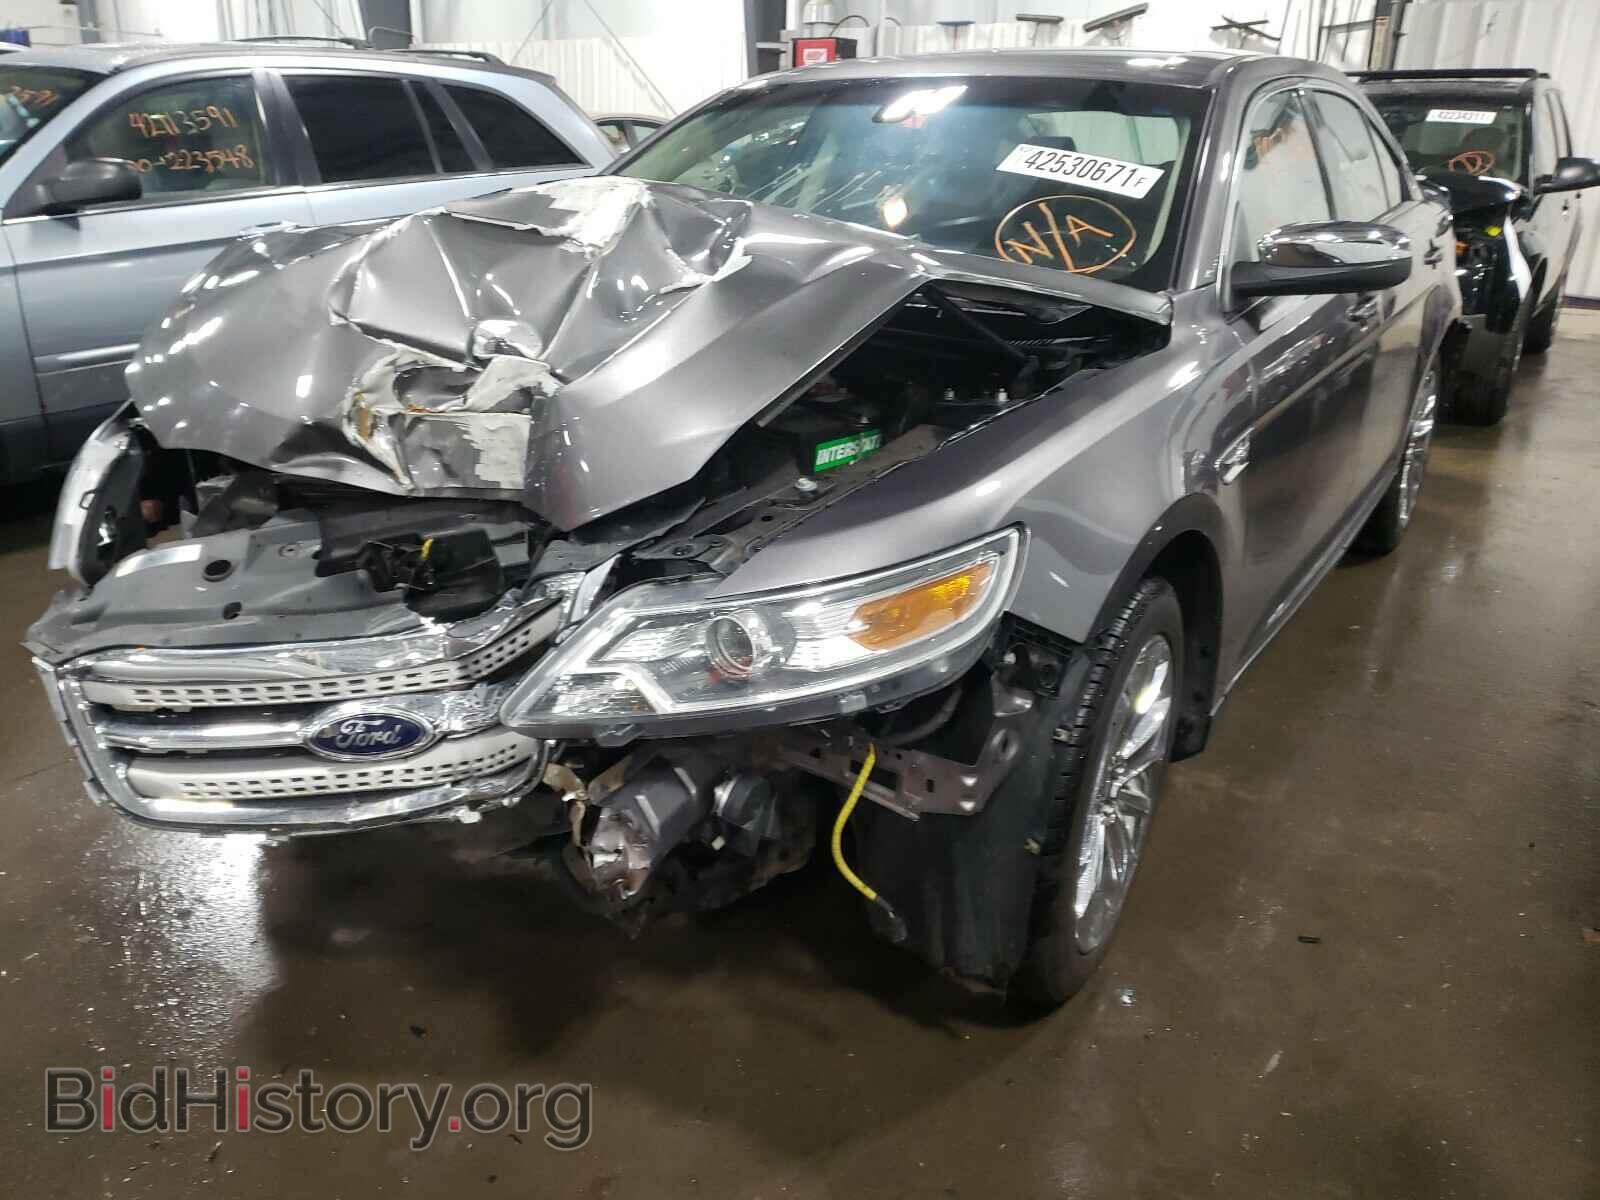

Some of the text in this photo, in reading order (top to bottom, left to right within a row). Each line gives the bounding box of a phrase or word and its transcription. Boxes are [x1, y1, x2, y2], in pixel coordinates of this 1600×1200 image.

[1024, 150, 1138, 187] 42530671
[1004, 202, 1115, 272] N/A
[335, 719, 402, 749] Ford
